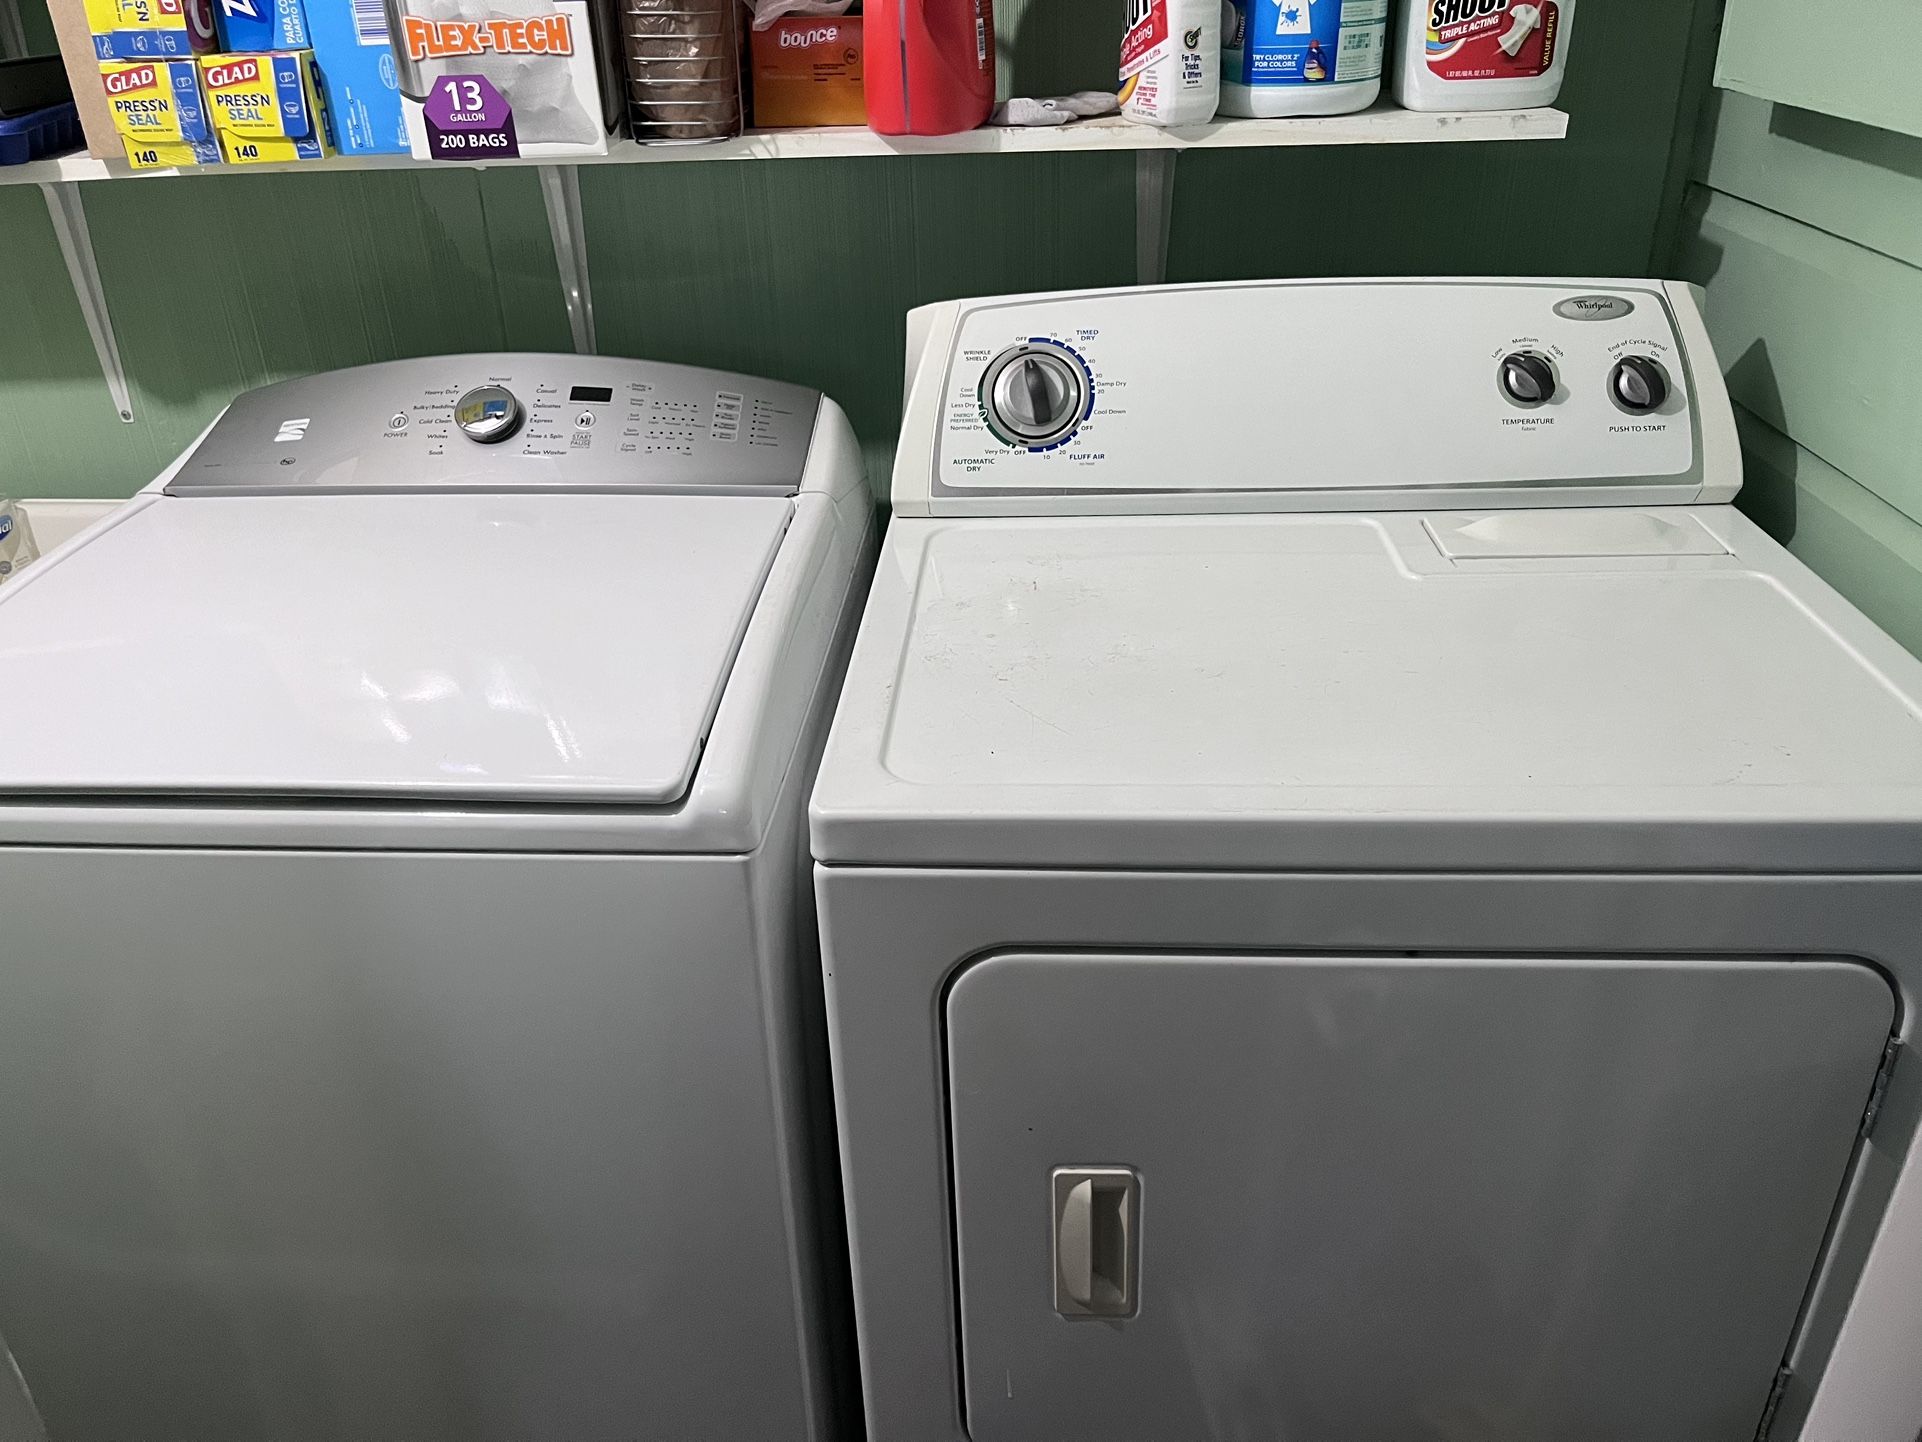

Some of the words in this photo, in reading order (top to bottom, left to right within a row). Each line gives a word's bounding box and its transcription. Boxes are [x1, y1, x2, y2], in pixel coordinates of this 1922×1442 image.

[283, 16, 296, 44] PARA
[290, 6, 304, 44] CUARTO
[1440, 24, 1468, 40] TRIPLE
[1468, 15, 1499, 32] ACTING
[1546, 10, 1556, 38] REFILL
[403, 14, 574, 60] FLEX-TECH
[780, 26, 838, 48] bounce
[1130, 24, 1153, 50] Acting
[1543, 38, 1552, 66] VALUE
[106, 69, 154, 93] GLAD
[207, 63, 256, 87] GLAD
[216, 93, 270, 107] PRESS'N
[444, 81, 484, 112] 13
[114, 98, 168, 112] PRESS'N
[128, 113, 162, 126] SEAL
[228, 108, 263, 121] SEAL
[450, 112, 486, 122] GALLON
[440, 134, 466, 149] 200
[470, 133, 508, 148] BAGS
[134, 150, 158, 164] 140
[234, 144, 258, 158] 140
[1572, 300, 1613, 312] Whirlpool
[1491, 348, 1503, 358] Low
[1551, 344, 1564, 357] High
[1608, 343, 1620, 352] End
[1648, 340, 1668, 352] Signal
[1613, 352, 1624, 360] Off
[1650, 350, 1660, 358] On
